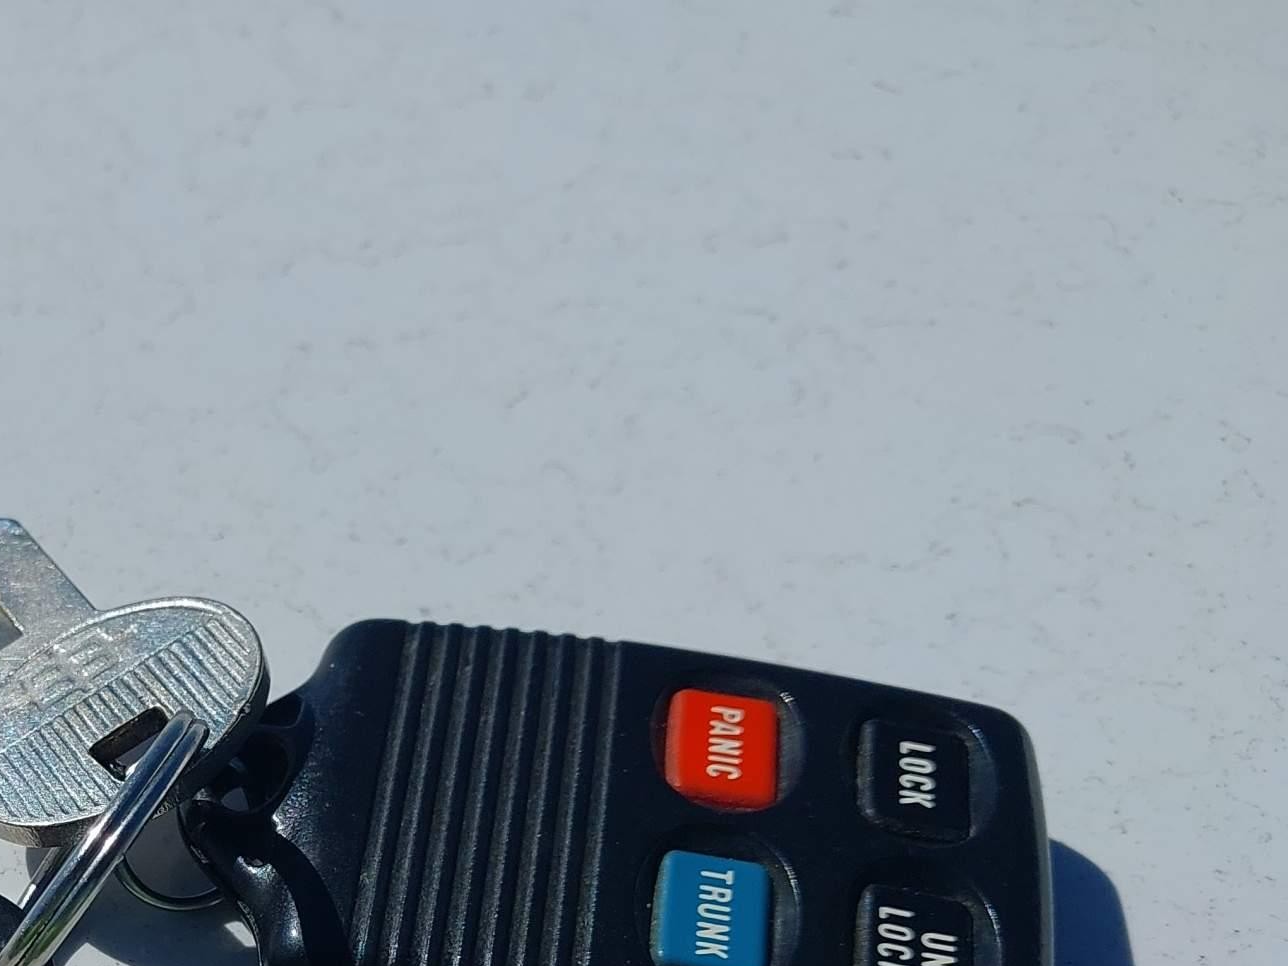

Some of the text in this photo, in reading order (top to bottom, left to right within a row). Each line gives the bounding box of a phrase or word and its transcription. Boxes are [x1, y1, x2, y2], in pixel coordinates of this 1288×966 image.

[706, 706, 744, 780] PANIC
[898, 741, 936, 809] LOCK
[695, 869, 734, 959] TRUNK
